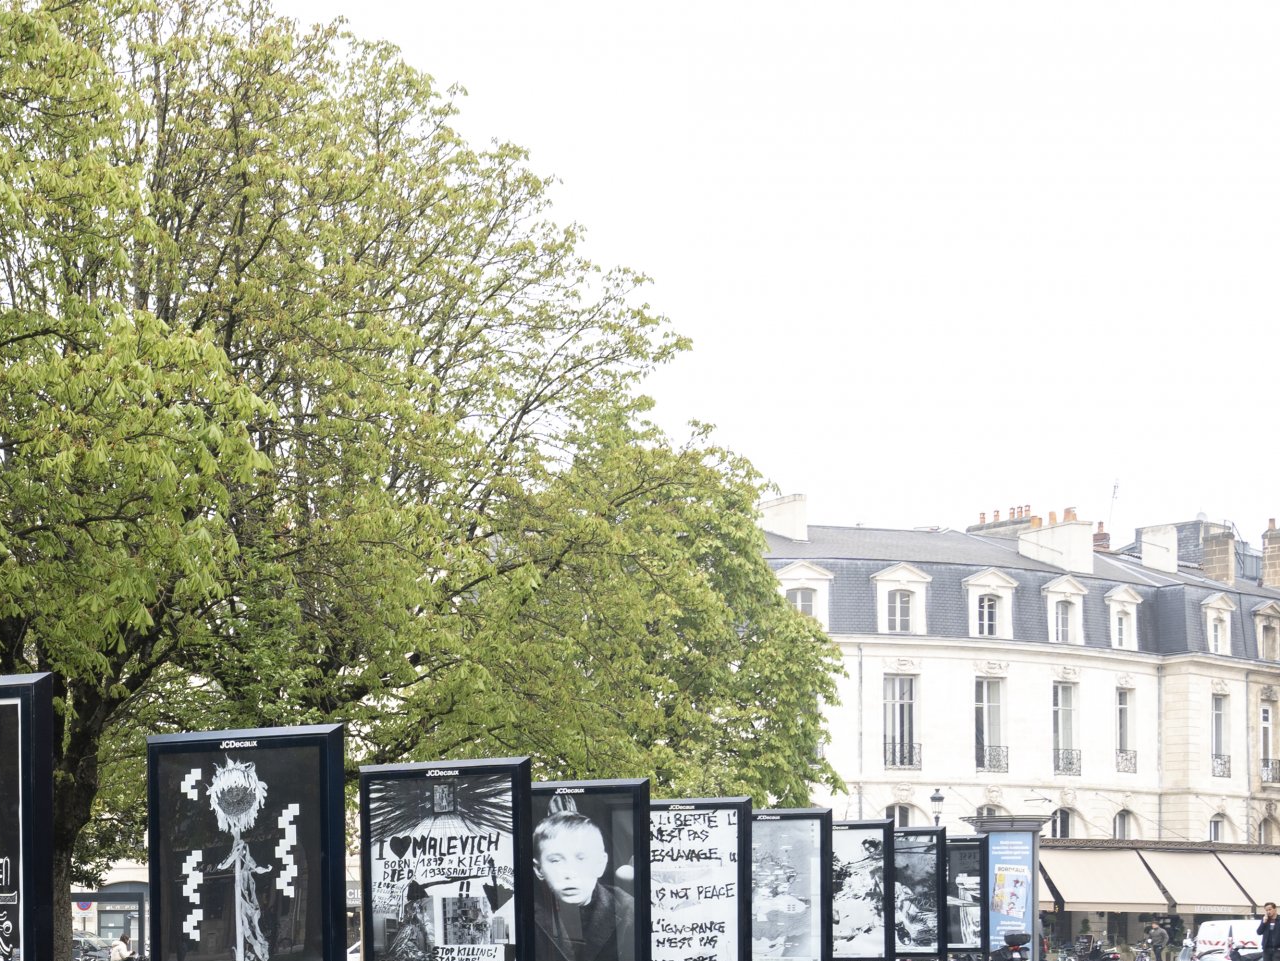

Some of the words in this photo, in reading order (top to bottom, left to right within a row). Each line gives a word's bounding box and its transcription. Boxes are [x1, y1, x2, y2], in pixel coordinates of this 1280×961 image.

[220, 740, 258, 749] JCDecaux
[425, 769, 459, 777] JCDecaux
[688, 829, 709, 842] PAS
[412, 831, 501, 859] MALEVICH
[458, 854, 490, 868] KIEV
[656, 887, 666, 901] IS
[670, 887, 691, 900] NOT
[697, 882, 735, 900] PEACE
[431, 946, 455, 956] STOP
